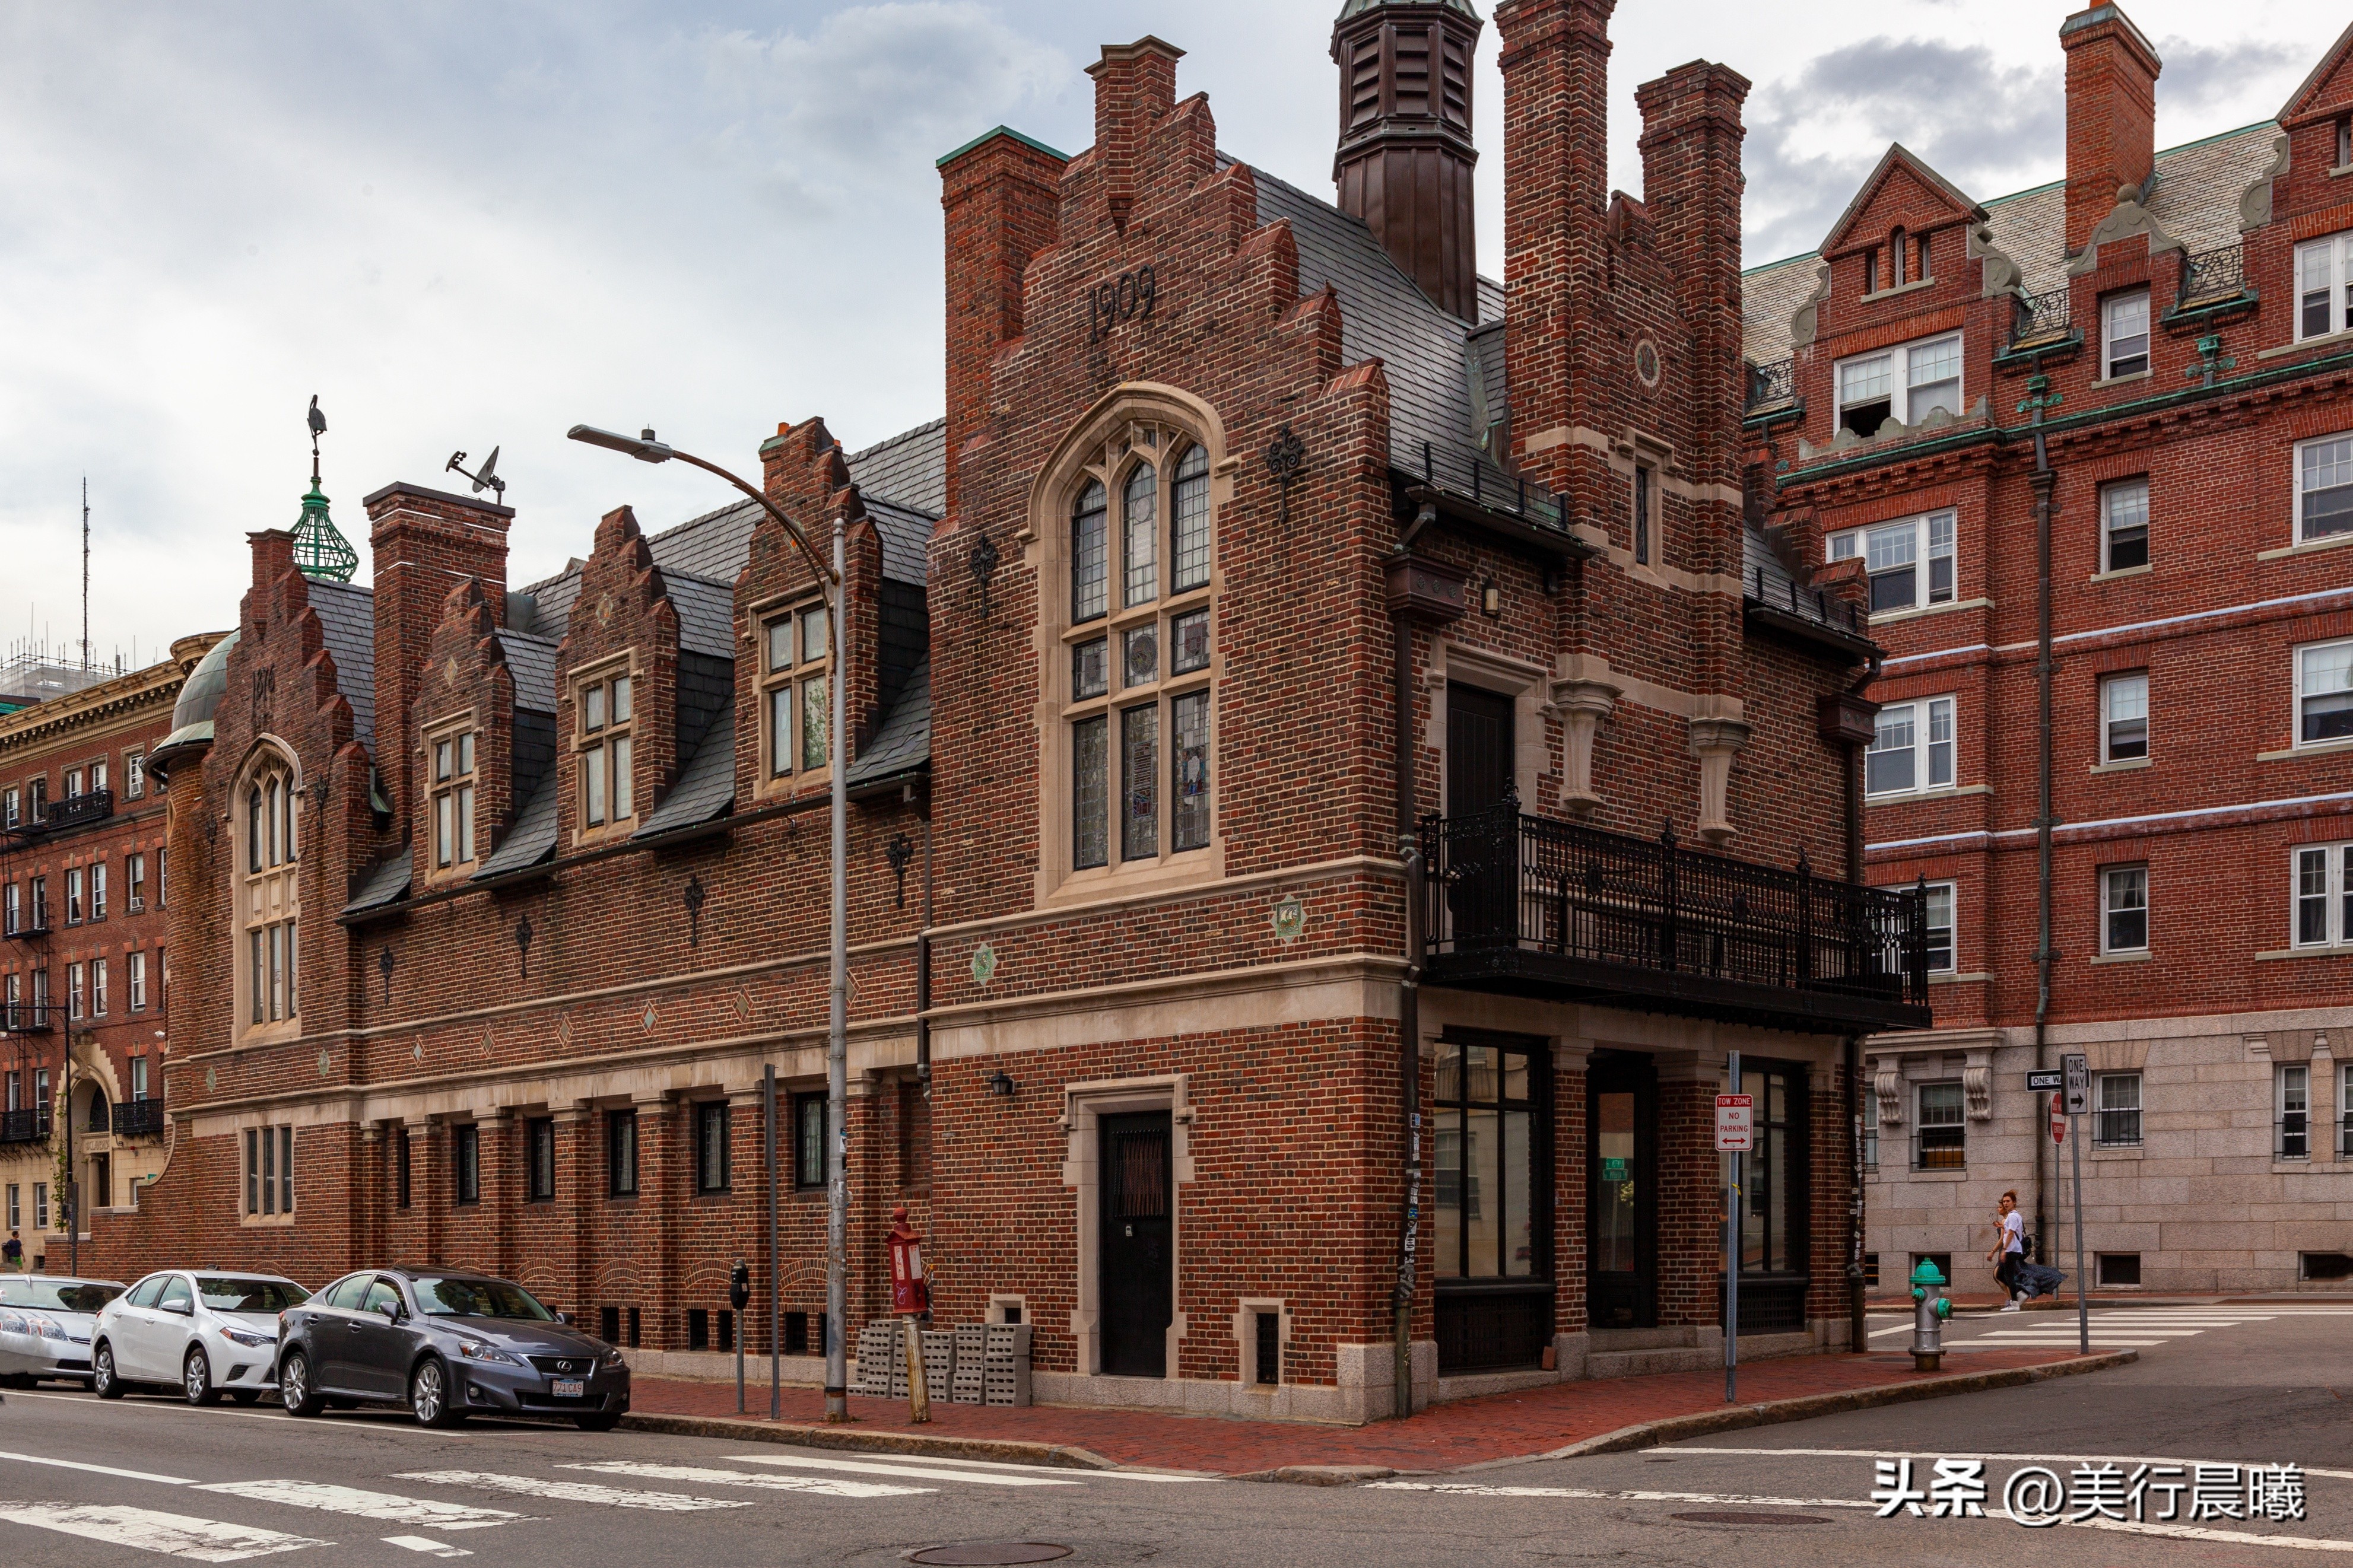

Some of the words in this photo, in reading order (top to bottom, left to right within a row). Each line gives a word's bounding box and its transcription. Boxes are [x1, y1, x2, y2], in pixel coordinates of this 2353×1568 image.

[1090, 263, 1154, 344] 1909
[252, 662, 275, 708] 1876
[2068, 1059, 2084, 1073] ONE
[2033, 1076, 2050, 1085] ONE
[2068, 1076, 2084, 1090] WAY
[553, 1383, 567, 1392] 771
